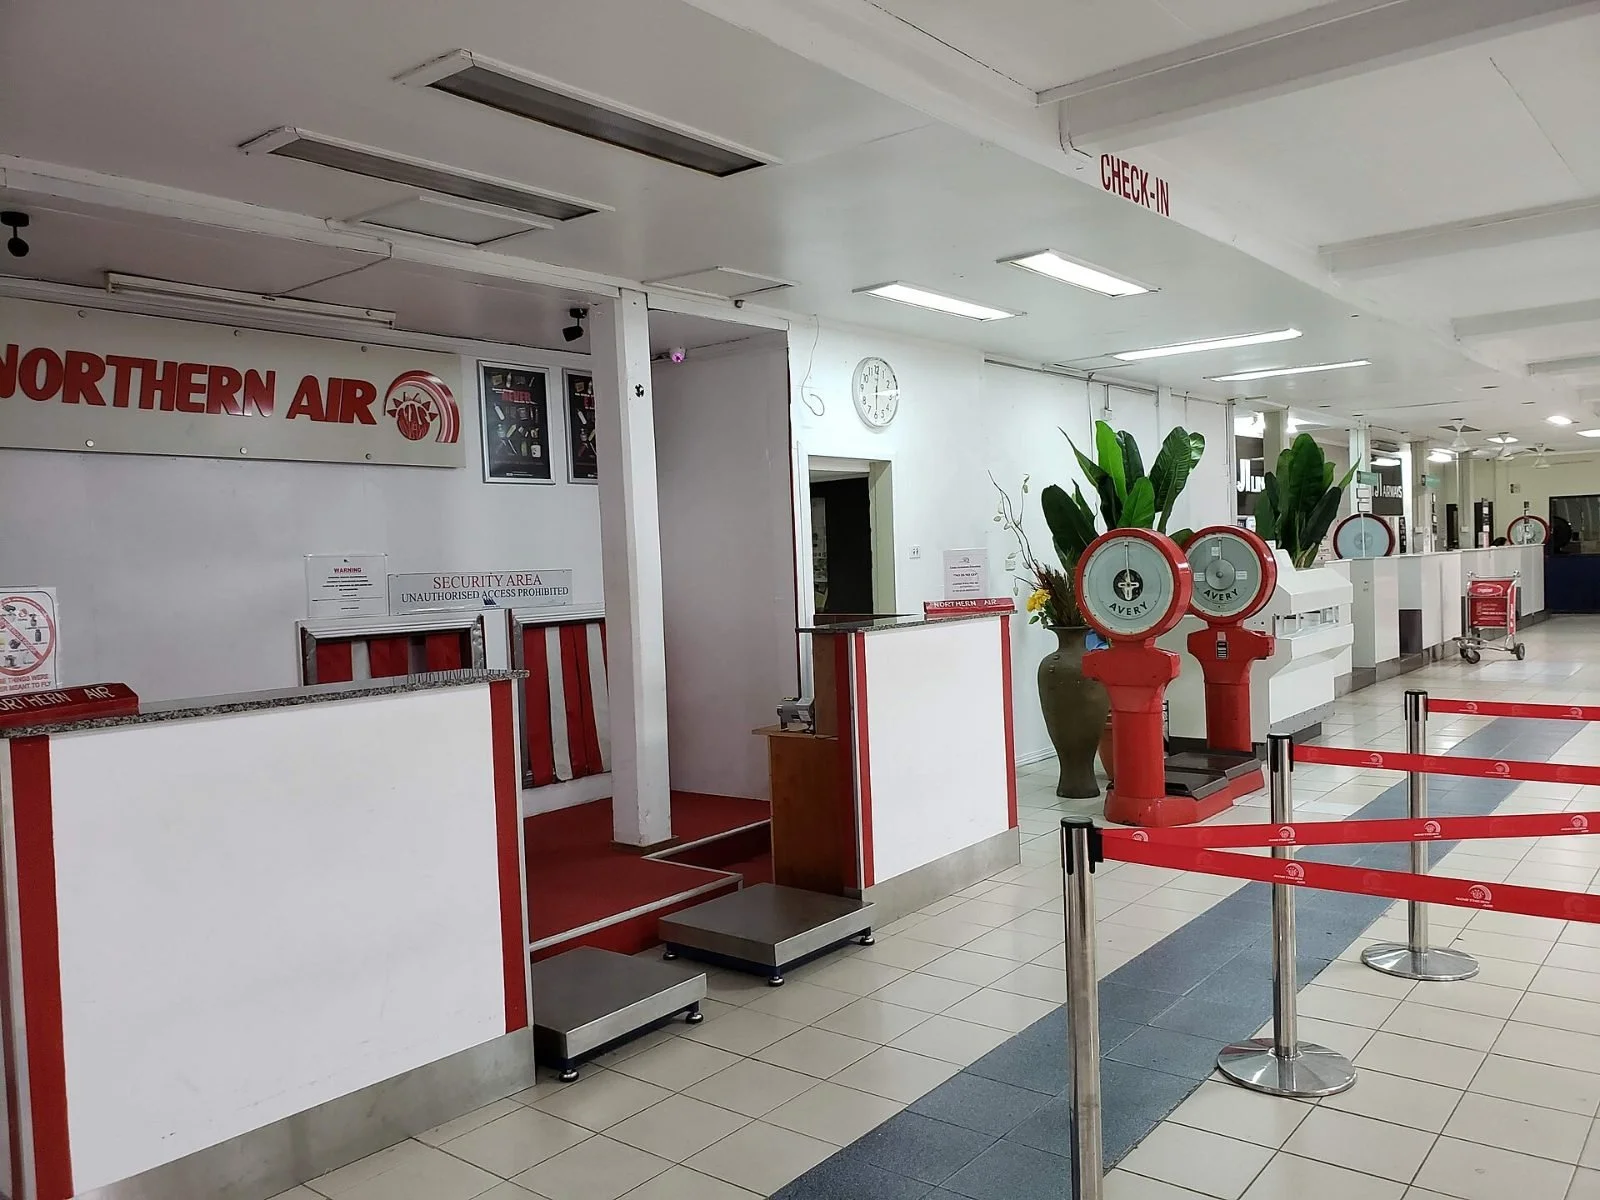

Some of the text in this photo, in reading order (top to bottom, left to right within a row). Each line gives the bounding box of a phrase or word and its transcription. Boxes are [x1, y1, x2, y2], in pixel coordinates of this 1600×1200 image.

[1101, 153, 1169, 217] CHECK-IN
[286, 374, 377, 425] AIR
[433, 573, 542, 589] SECURITY AREA
[401, 586, 569, 603] UNAUTHORISED ACCESS PROHIBITED
[1203, 588, 1239, 601] AVERY
[934, 600, 977, 608] NORTHERN
[1109, 601, 1149, 616] AVERY
[83, 686, 116, 700] AIR
